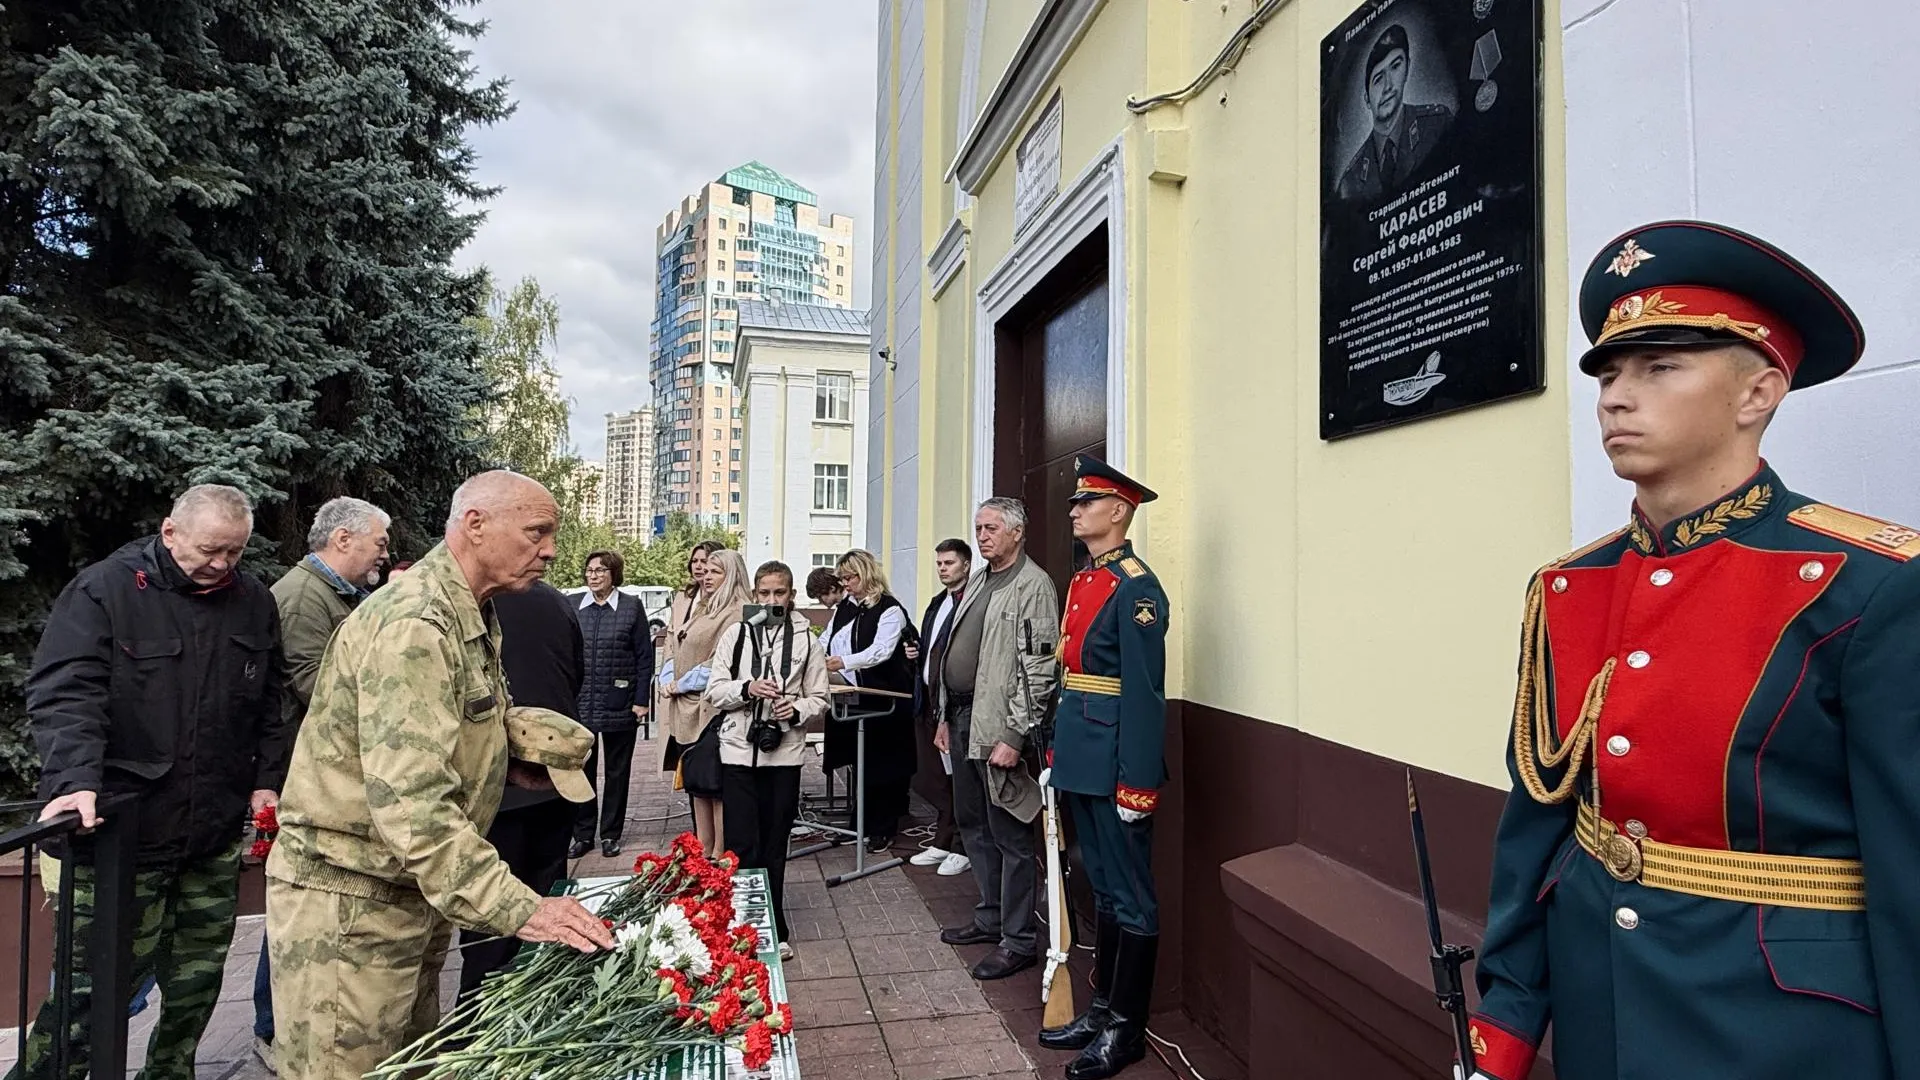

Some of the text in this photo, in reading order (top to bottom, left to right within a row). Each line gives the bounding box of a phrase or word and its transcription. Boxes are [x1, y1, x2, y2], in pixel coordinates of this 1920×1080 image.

[1345, 10, 1377, 42] Памяти
[1368, 164, 1461, 222] Старший лейтенант
[1379, 190, 1448, 240] КАРАСЕВ
[1352, 199, 1483, 273] Сергей Федорович
[1368, 233, 1462, 284] 09.10.1957-01.08.1983
[1356, 302, 1391, 321] отдельного
[1392, 273, 1461, 310] разведывательного
[1461, 256, 1504, 279] батальона
[1381, 261, 1457, 301] десантно-штурмового
[1458, 249, 1486, 267] взвода
[1343, 312, 1391, 338] мотострелковой
[1424, 285, 1465, 307] Выпускник
[1466, 274, 1495, 291] школы
[1496, 264, 1515, 280] 1975
[1355, 330, 1384, 346] мужество
[1415, 299, 1463, 325] проявленные
[1354, 355, 1380, 371] орденом
[1411, 334, 1441, 352] Знамени
[1382, 332, 1411, 348] медалью
[1425, 317, 1453, 333] боевые
